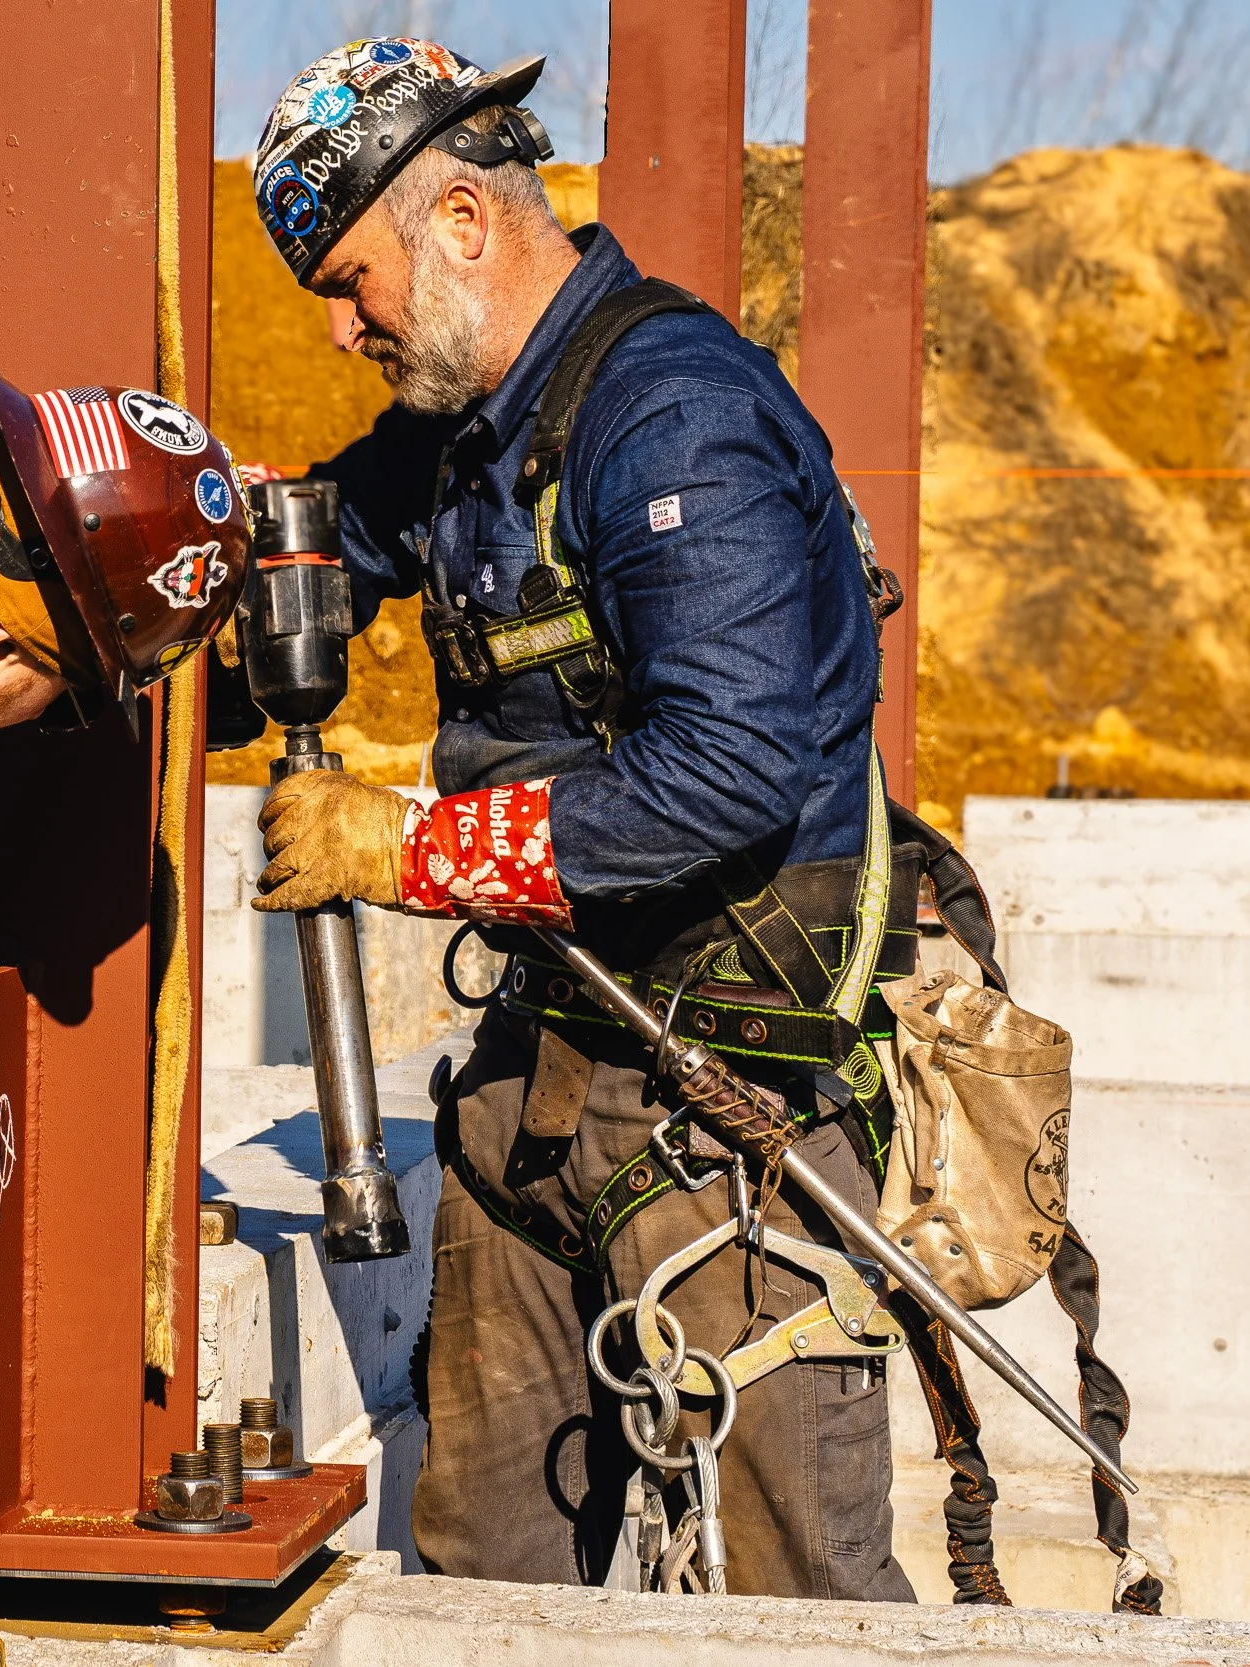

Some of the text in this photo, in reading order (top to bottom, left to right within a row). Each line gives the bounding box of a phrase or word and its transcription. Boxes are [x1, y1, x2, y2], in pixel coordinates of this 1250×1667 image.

[302, 150, 342, 193] We
[327, 118, 370, 161] the
[352, 67, 435, 124] People
[265, 166, 295, 204] POLICE
[281, 190, 295, 206] NYPD
[651, 499, 675, 511] NFPA
[652, 509, 669, 519] 2112
[454, 801, 480, 853] 76s
[489, 788, 514, 861] Aloha
[1045, 1114, 1070, 1140] KLE
